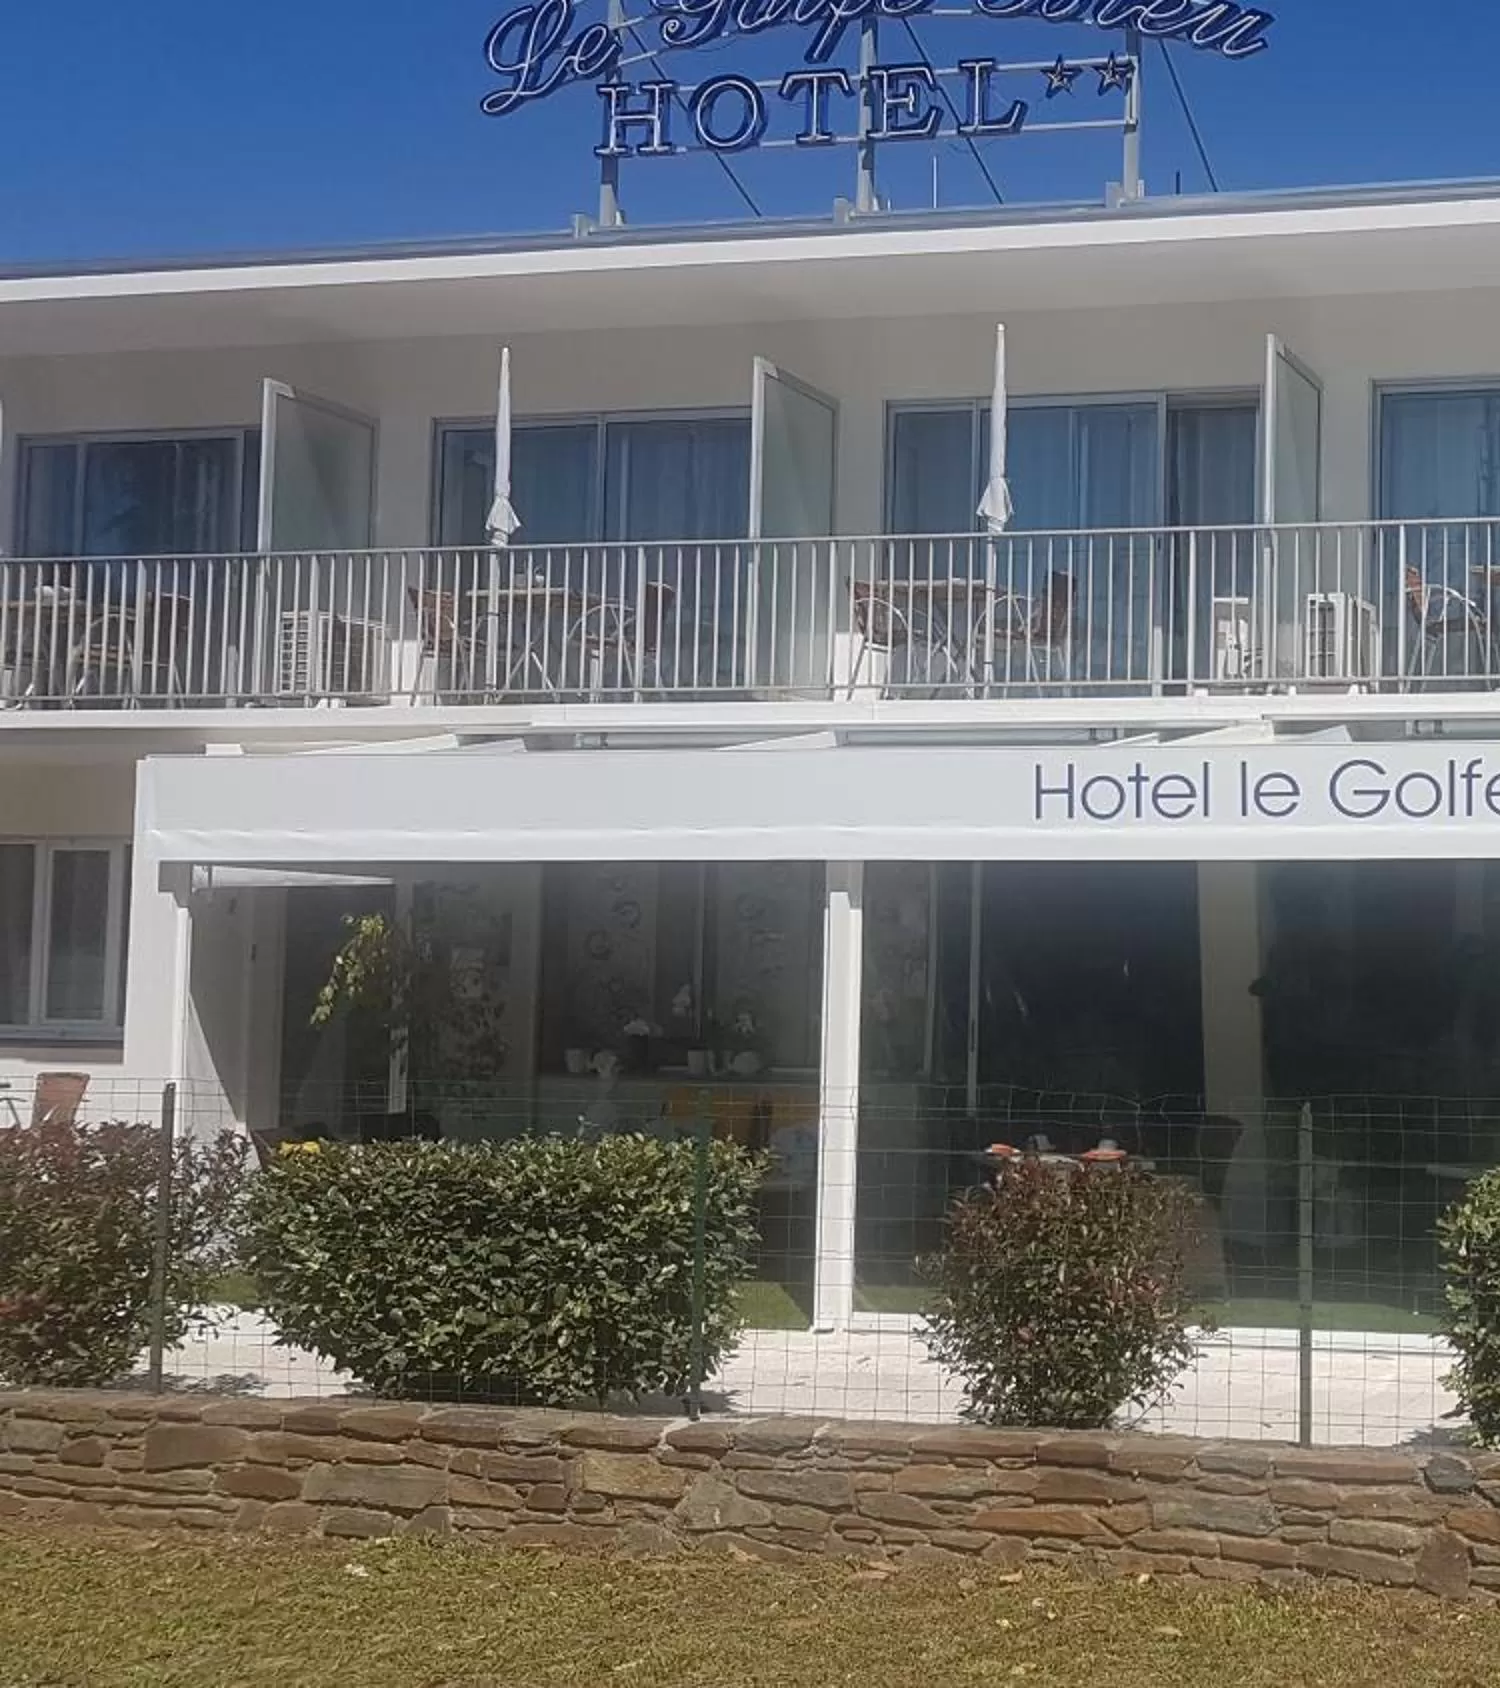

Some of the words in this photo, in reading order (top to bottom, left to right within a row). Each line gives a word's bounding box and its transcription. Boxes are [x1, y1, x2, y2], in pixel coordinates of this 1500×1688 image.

[476, 0, 623, 116] Le
[594, 58, 1028, 157] HOTEL
[1034, 760, 1211, 820] Hotel
[1240, 760, 1301, 819] le
